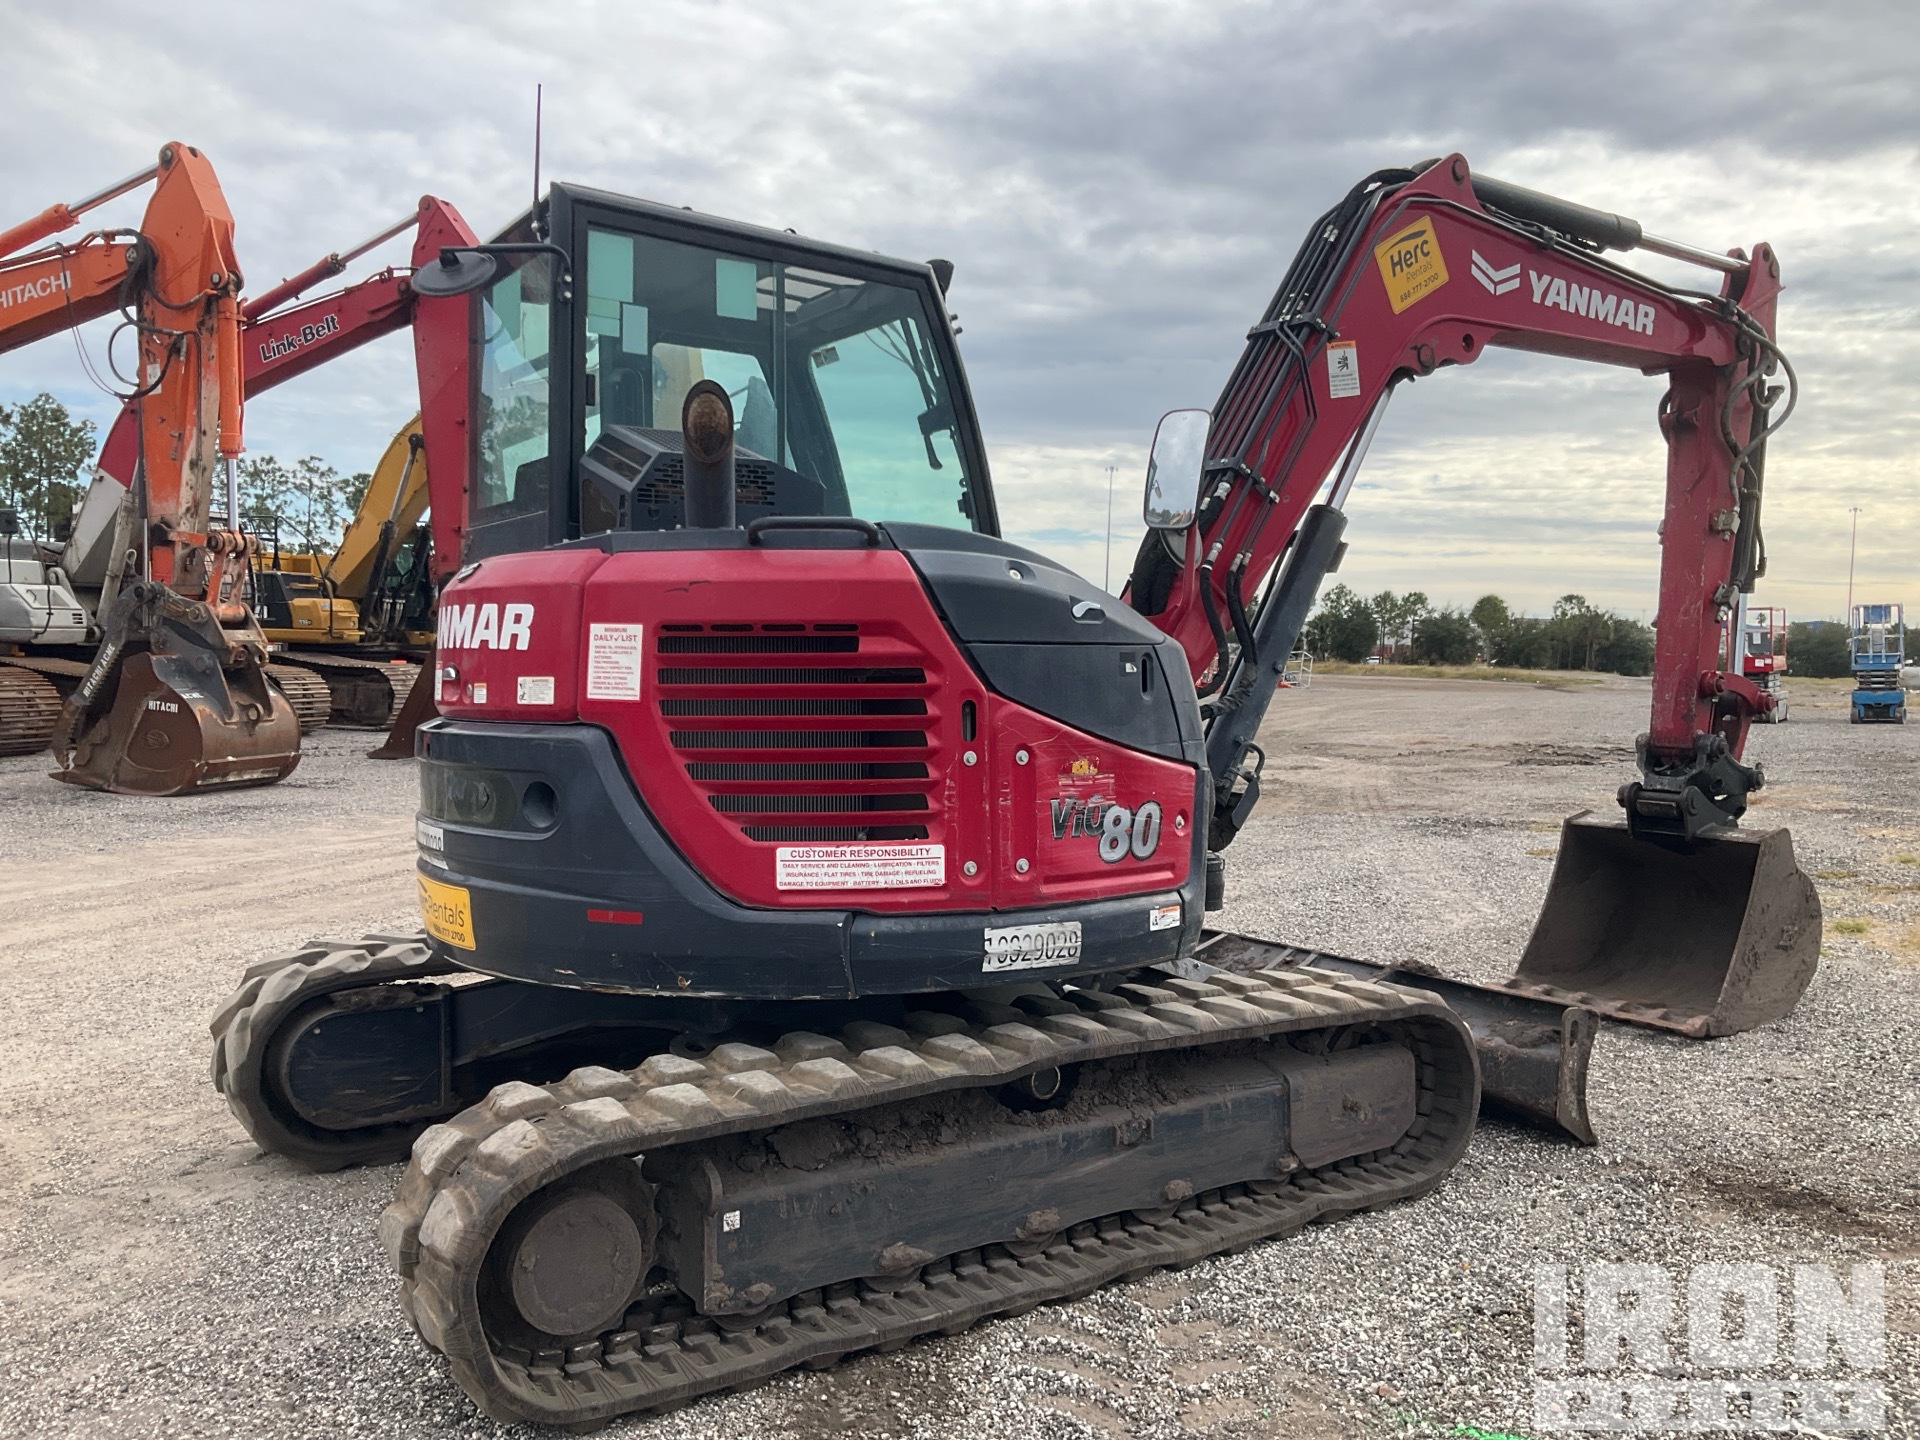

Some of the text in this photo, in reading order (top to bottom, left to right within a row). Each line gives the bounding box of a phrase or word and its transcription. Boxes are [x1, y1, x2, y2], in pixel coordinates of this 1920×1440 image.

[1390, 240, 1430, 278] Herc
[1406, 260, 1433, 283] Rentals
[1528, 270, 1656, 336] YANMAR
[260, 313, 339, 362] Link-Belt
[621, 634, 638, 642] LIST
[82, 665, 104, 698] HITACHI
[148, 700, 179, 713] HITACHI
[1099, 801, 1163, 864] 80
[790, 847, 931, 858] CUSTOMER RESPONSIBILITY
